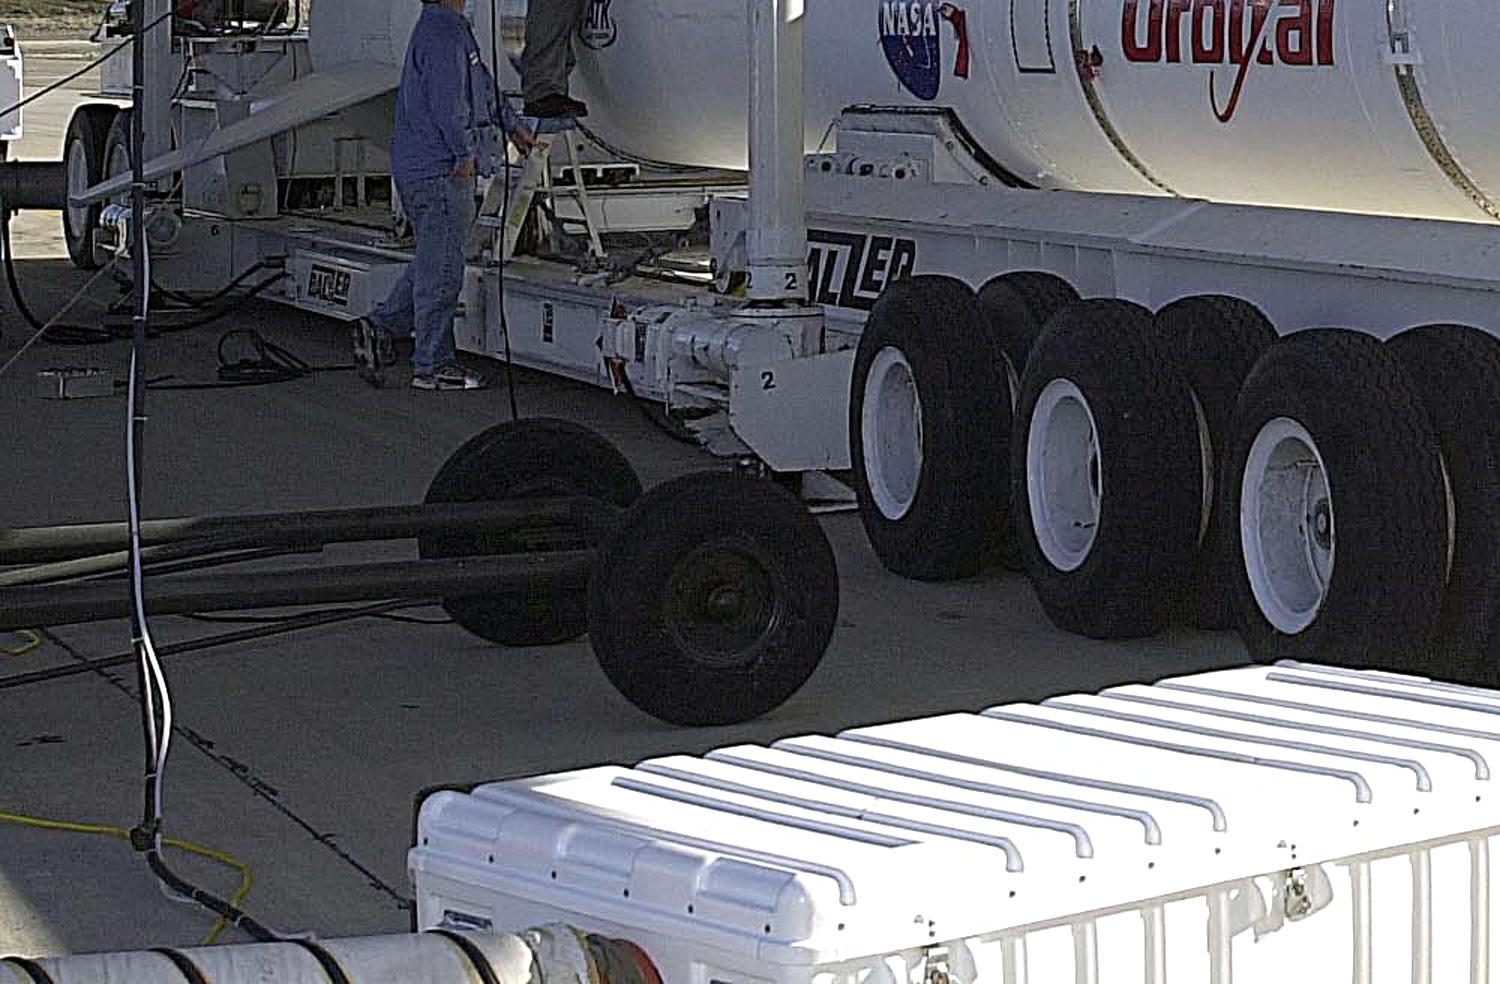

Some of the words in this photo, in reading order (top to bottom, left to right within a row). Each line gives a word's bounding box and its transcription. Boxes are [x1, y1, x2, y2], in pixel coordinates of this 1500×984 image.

[883, 1, 937, 36] NASA
[784, 272, 797, 290] 2
[761, 371, 775, 390] 2
